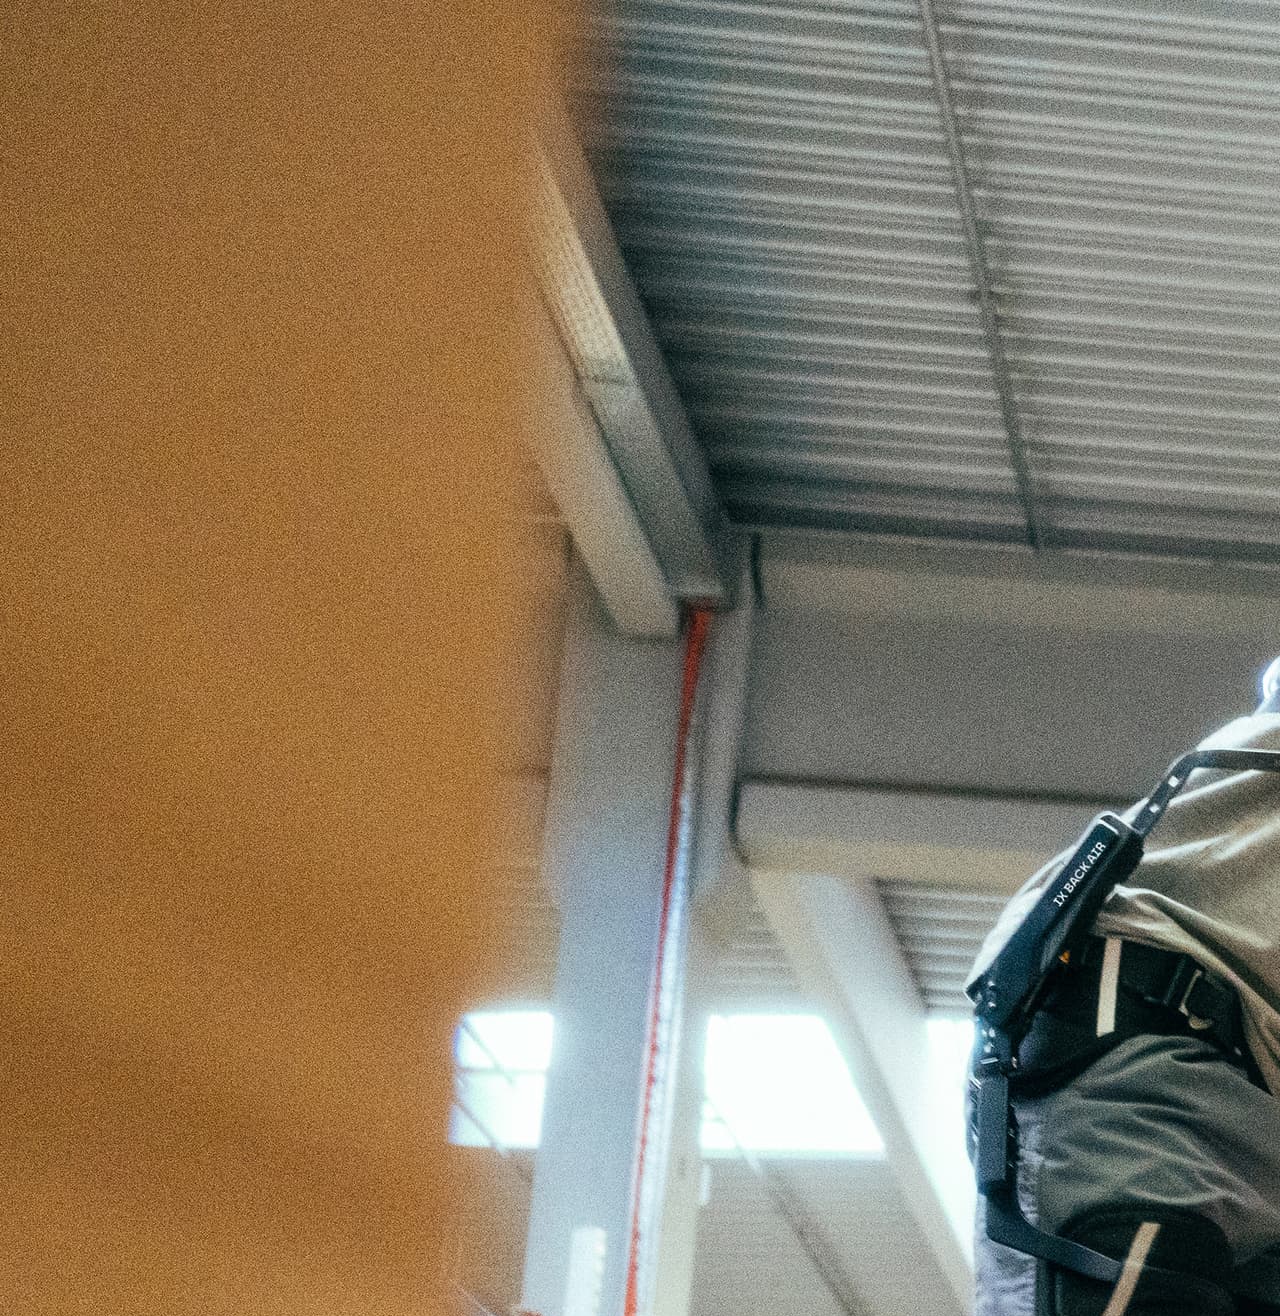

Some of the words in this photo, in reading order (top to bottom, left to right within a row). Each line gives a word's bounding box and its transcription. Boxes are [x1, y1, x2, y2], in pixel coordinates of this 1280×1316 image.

[1053, 891, 1069, 907] IX
[1063, 861, 1091, 894] BACK
[1087, 841, 1107, 865] AIR
